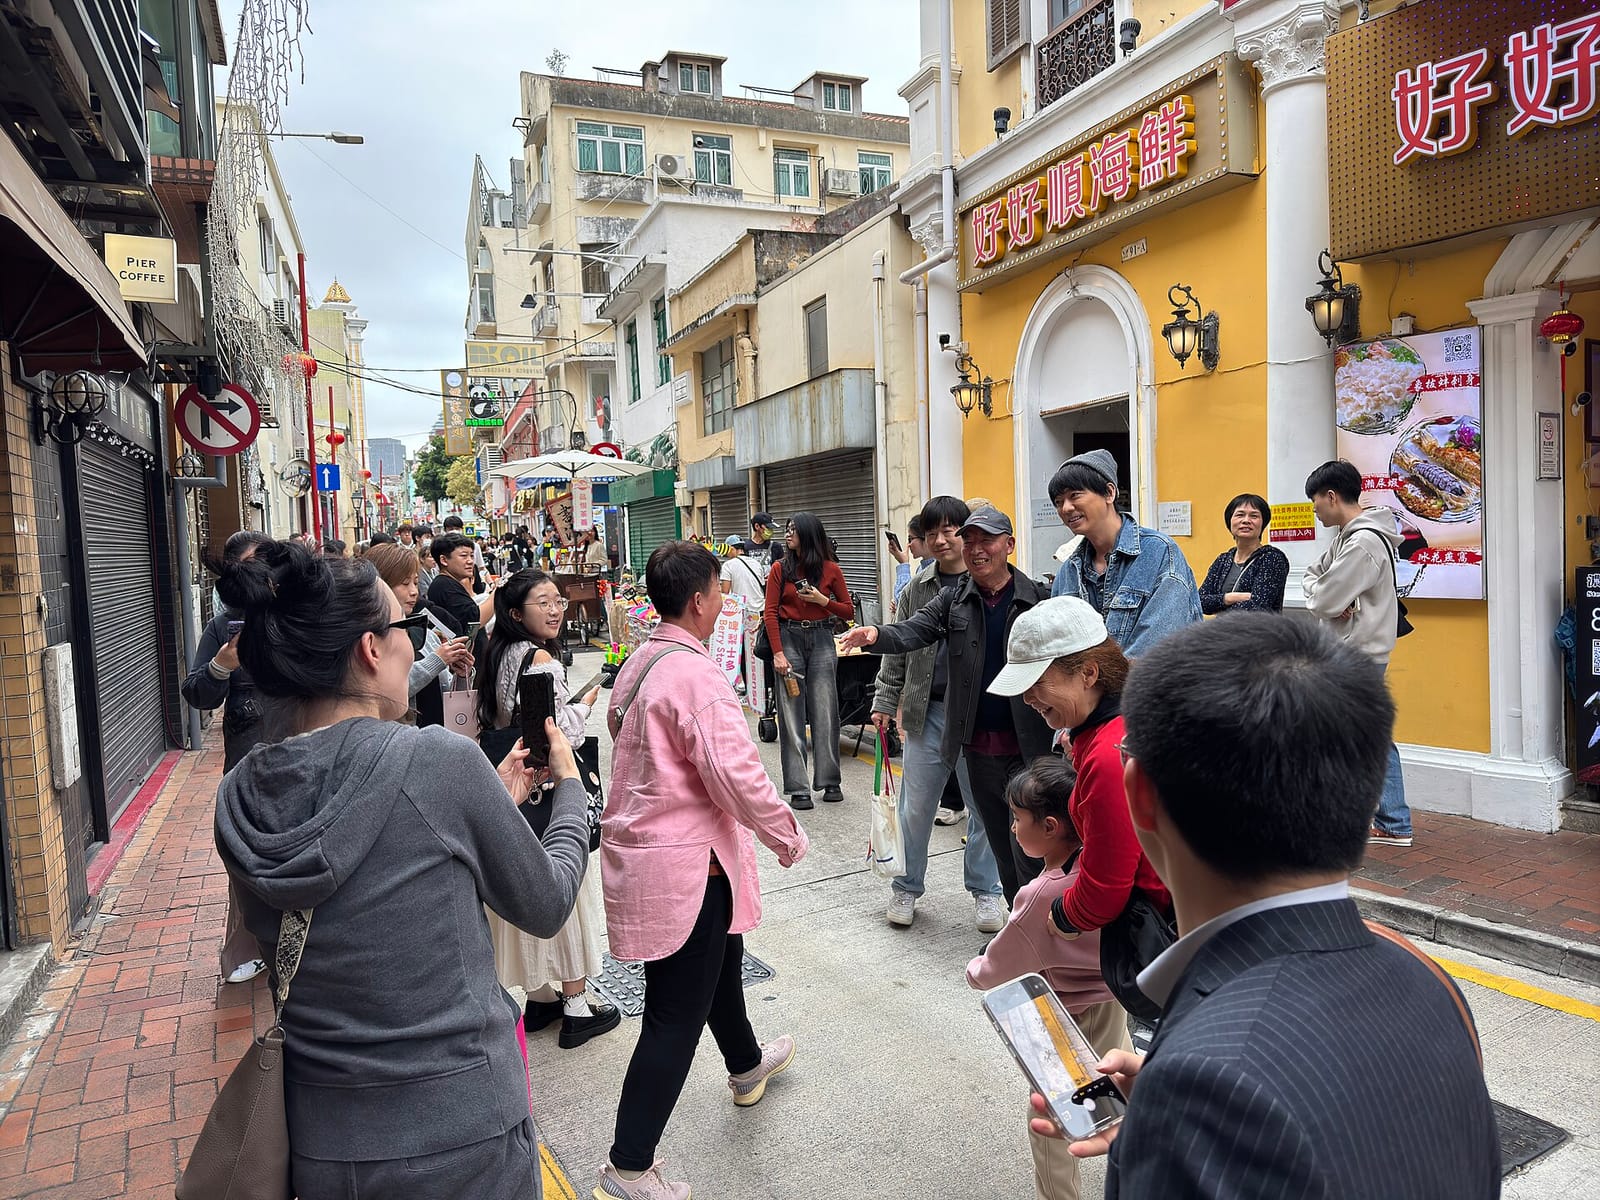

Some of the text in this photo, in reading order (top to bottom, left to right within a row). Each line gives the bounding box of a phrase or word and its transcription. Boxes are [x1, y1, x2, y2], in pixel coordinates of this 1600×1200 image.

[972, 96, 1188, 268] 好好順海鮮
[127, 257, 156, 268] PIER
[119, 270, 166, 283] COFFEE
[1414, 372, 1475, 392] 象拔蚌刺身
[1418, 551, 1468, 563] 冰花燕窩
[717, 619, 728, 645] Berry
